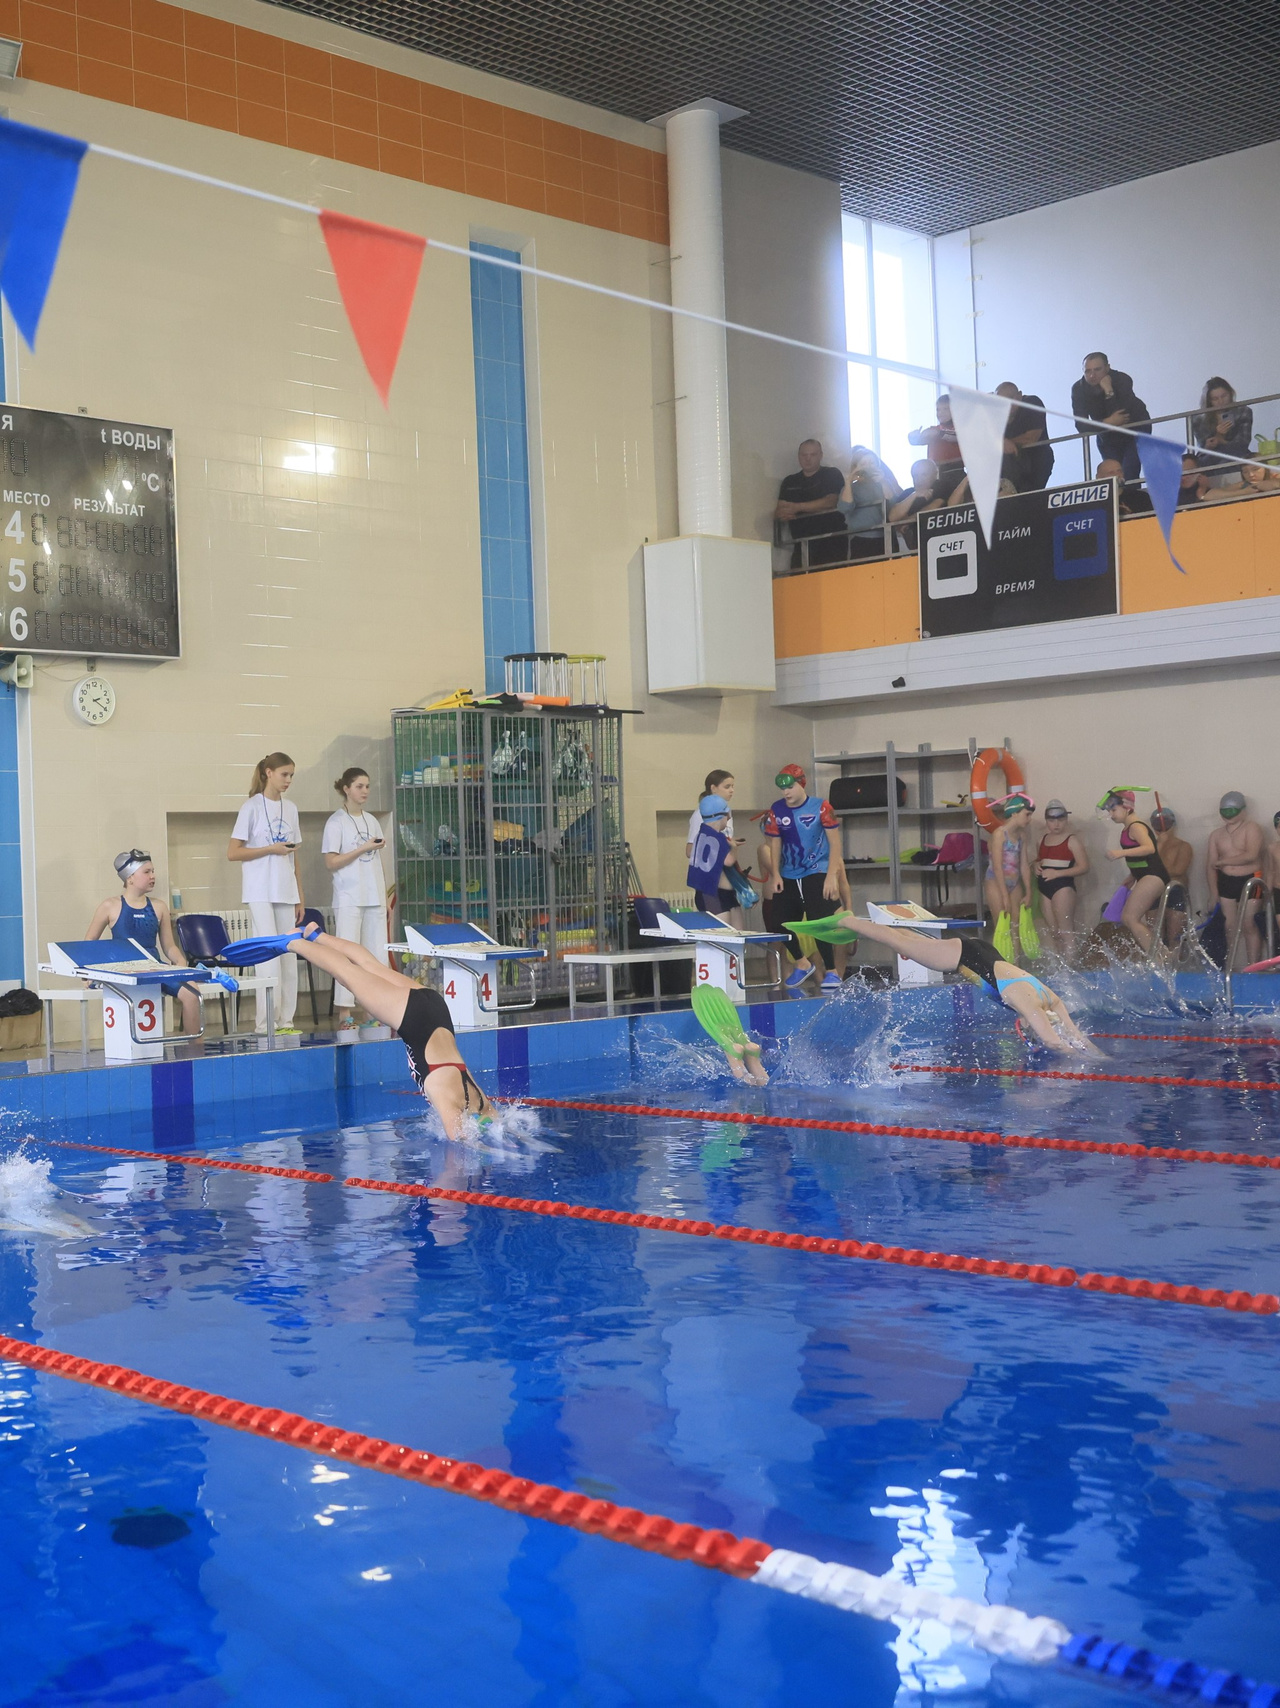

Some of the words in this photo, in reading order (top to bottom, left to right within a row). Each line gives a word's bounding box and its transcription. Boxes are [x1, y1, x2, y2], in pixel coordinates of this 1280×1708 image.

[100, 428, 107, 443] t
[111, 429, 161, 451] ВОДЫ
[3, 489, 51, 507] МЕСТО
[1050, 484, 1108, 508] СИНИЕ
[74, 498, 146, 517] РЕЗУЛЬТАТ
[4, 510, 25, 545] 4
[926, 508, 976, 530] БЕЛЫЕ
[1065, 518, 1094, 532] СЧЕТ
[998, 526, 1031, 541] ТАЙМ
[938, 540, 965, 553] СЧЕТ
[8, 557, 27, 592] 5
[995, 580, 1036, 595] ВРЕМЯ
[9, 606, 29, 641] 6
[698, 963, 710, 981] 5
[445, 980, 457, 999] 4
[105, 1006, 116, 1028] 3
[137, 999, 157, 1032] 3
